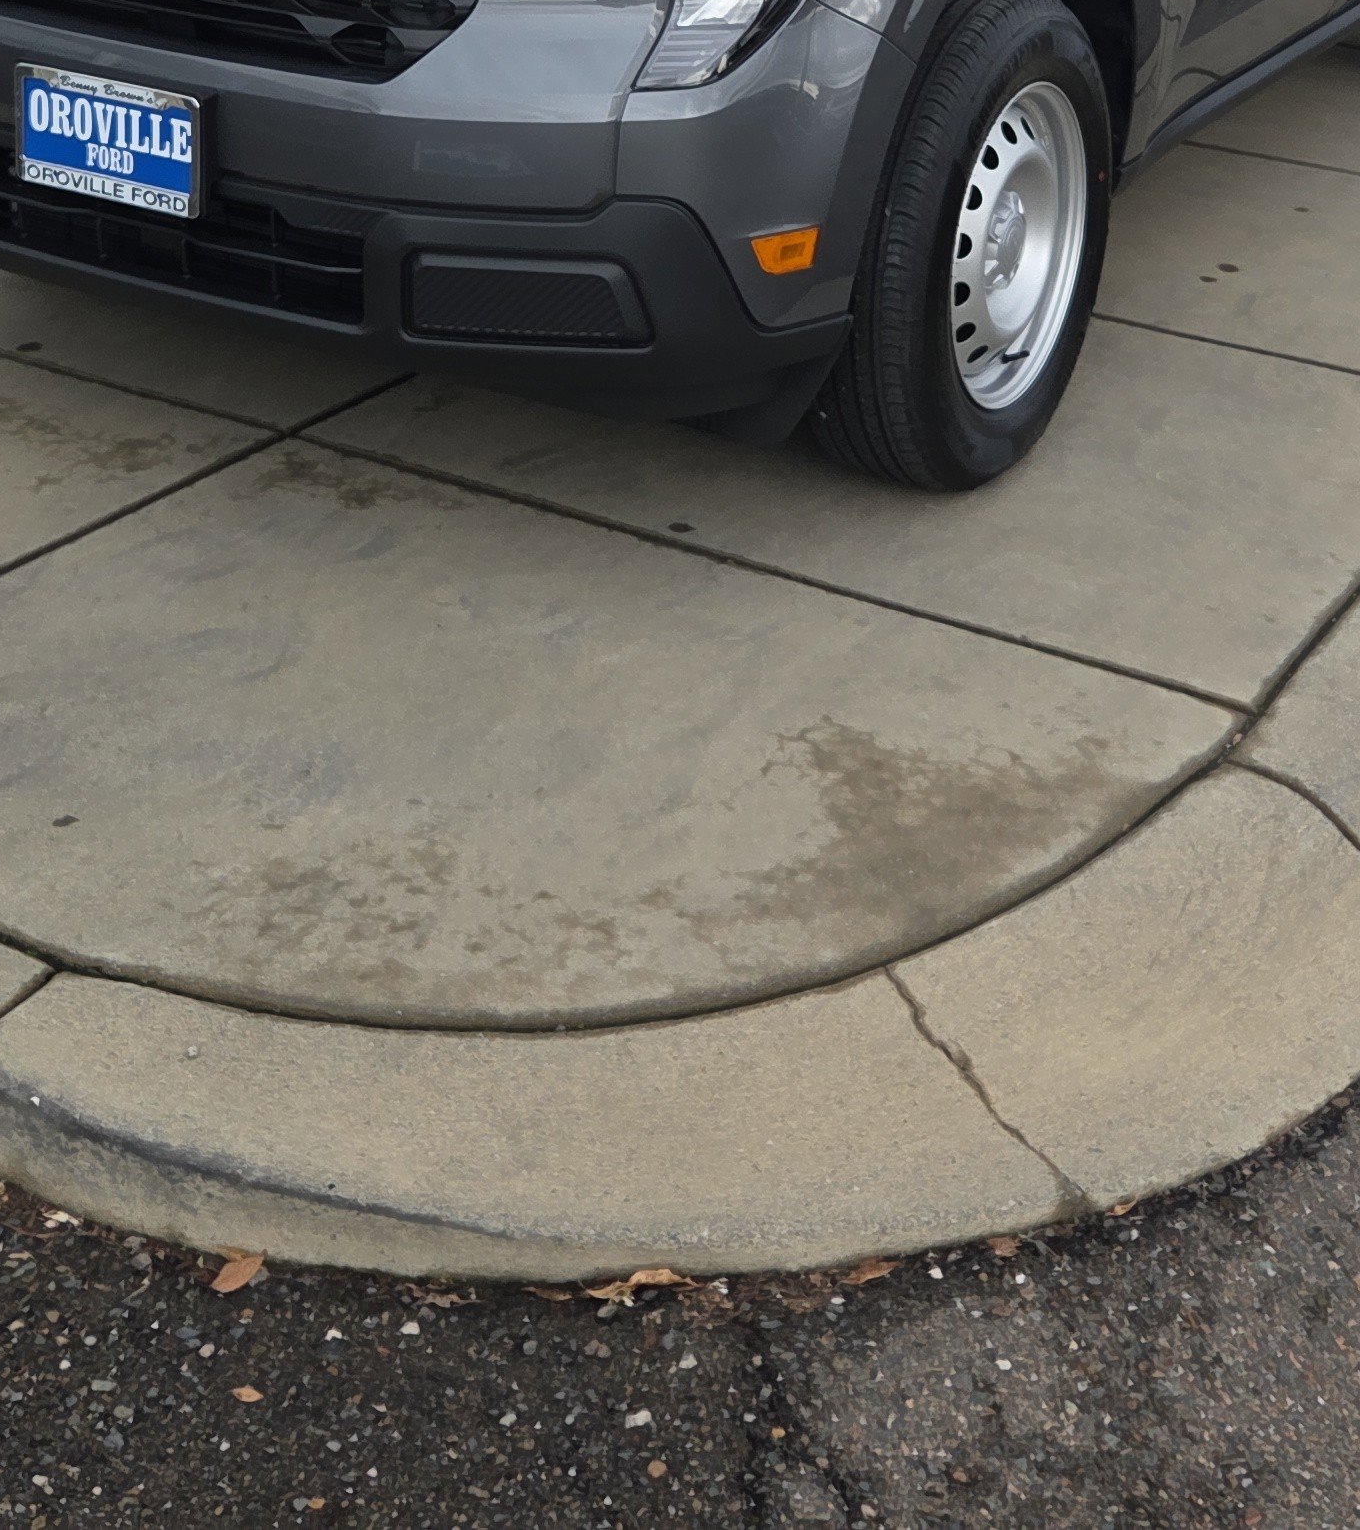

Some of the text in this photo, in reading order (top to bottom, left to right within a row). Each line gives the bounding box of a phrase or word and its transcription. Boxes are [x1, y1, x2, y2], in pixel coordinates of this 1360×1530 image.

[59, 74, 154, 104] Benny Brown's
[29, 88, 192, 163] OROVILLE
[86, 142, 135, 175] FORD
[26, 163, 187, 213] OROVILLE FORD
